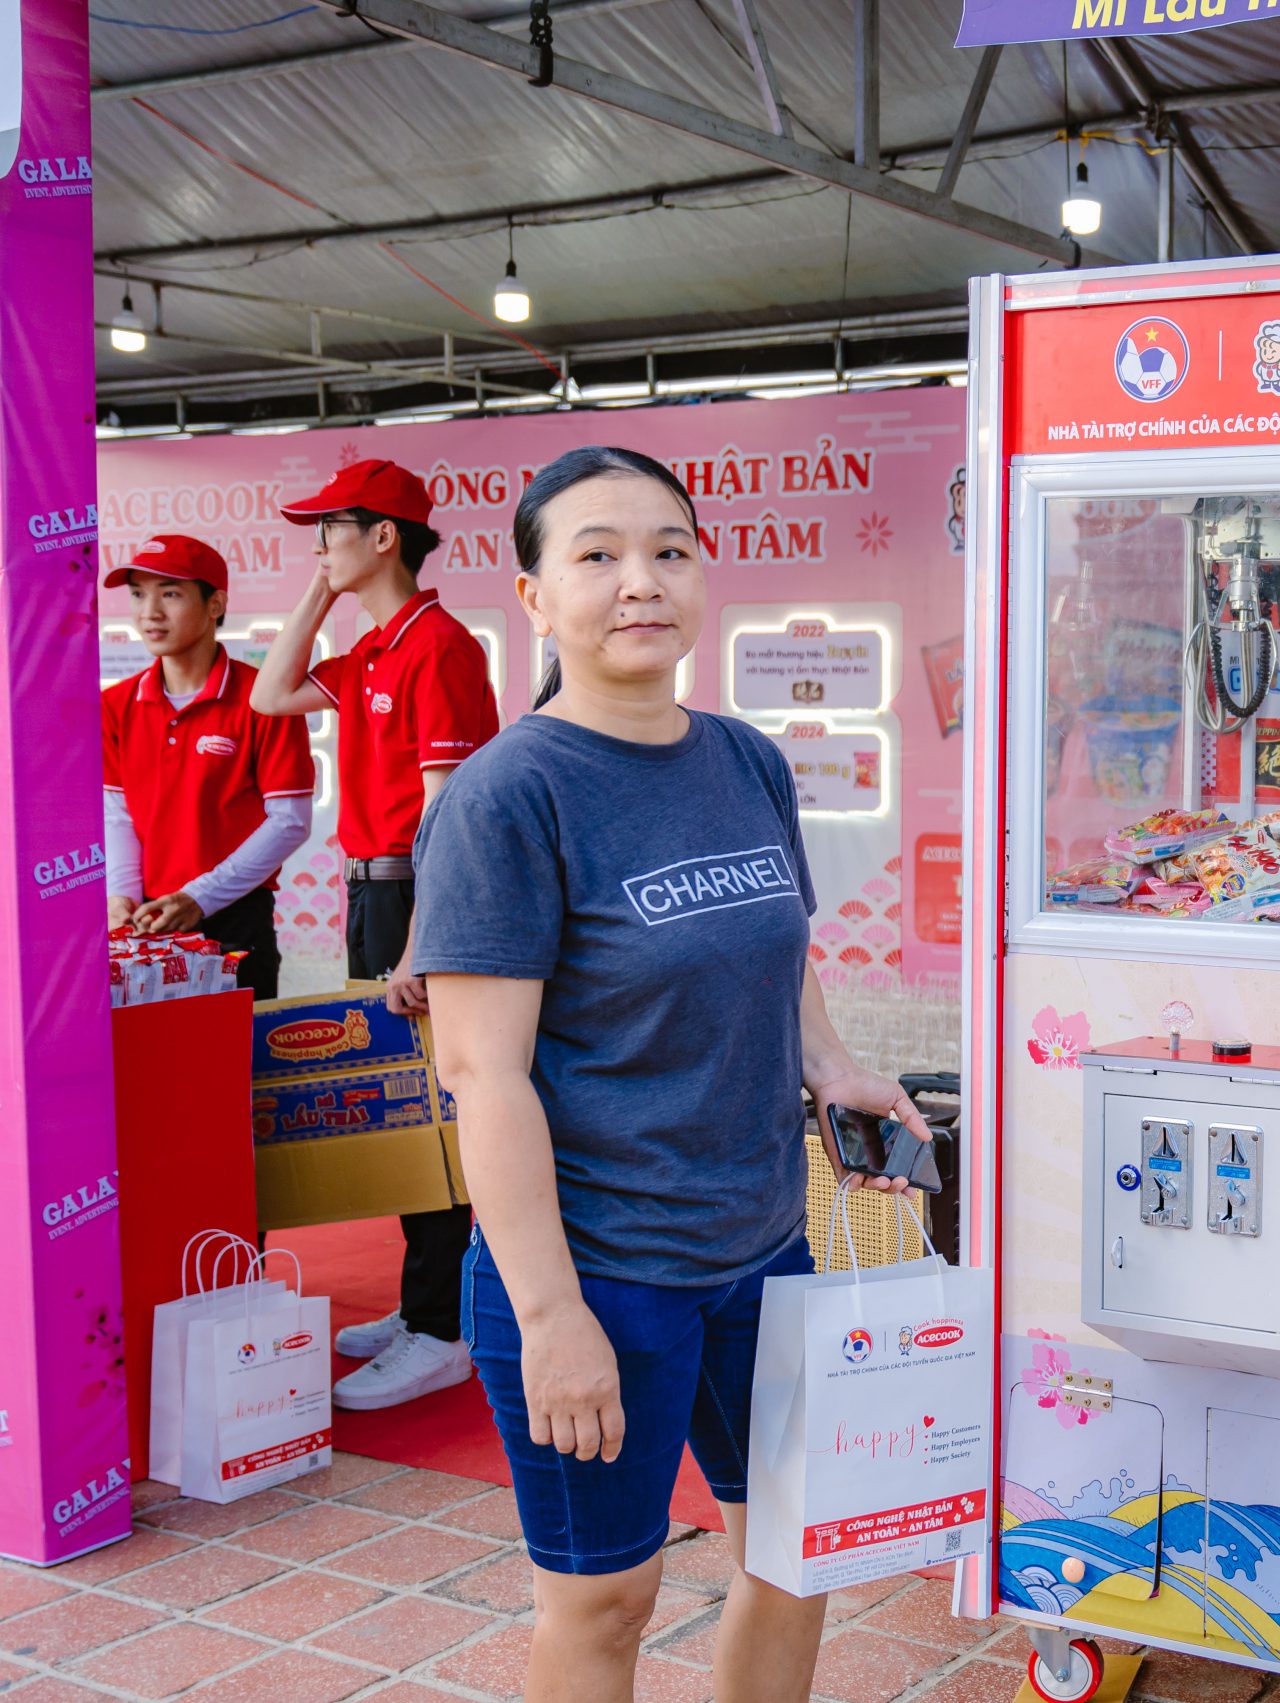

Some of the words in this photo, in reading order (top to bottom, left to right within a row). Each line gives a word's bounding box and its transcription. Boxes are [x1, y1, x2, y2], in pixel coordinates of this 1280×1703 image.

[1142, 379, 1161, 390] VFF
[1048, 422, 1080, 441] NHÀ
[1082, 420, 1104, 439] TÀI
[1107, 421, 1137, 441] TRỢ
[1139, 417, 1186, 437] CHÍNH
[1189, 414, 1221, 434] CỦA
[1223, 414, 1255, 432] CÁC
[782, 439, 872, 493] BẢN
[419, 463, 506, 506] ÔNG
[102, 485, 282, 528] ACECOOK
[447, 533, 500, 568] AN
[731, 512, 823, 560] TÂM
[793, 625, 826, 638] 2022
[791, 726, 825, 739] 2024
[33, 843, 106, 885] GALA
[640, 857, 791, 913] CHARNEL
[42, 1170, 119, 1226] GALA
[913, 1320, 930, 1332] Cook
[932, 1317, 964, 1326] happiness
[834, 1420, 916, 1459] happy
[931, 1430, 950, 1440] Happy
[951, 1424, 981, 1436] Customers
[931, 1443, 950, 1452] Happy
[951, 1436, 981, 1448] Employees
[930, 1455, 950, 1465] Happy
[950, 1450, 971, 1461] Society
[846, 1518, 874, 1532] CÔNG
[877, 1511, 905, 1527] NGHỆ
[907, 1505, 932, 1520] NHẬT
[934, 1501, 953, 1515] BẢN
[856, 1531, 871, 1544] AN
[873, 1525, 900, 1540] TOÀN
[908, 1522, 924, 1534] AN
[925, 1517, 943, 1530] TÂM
